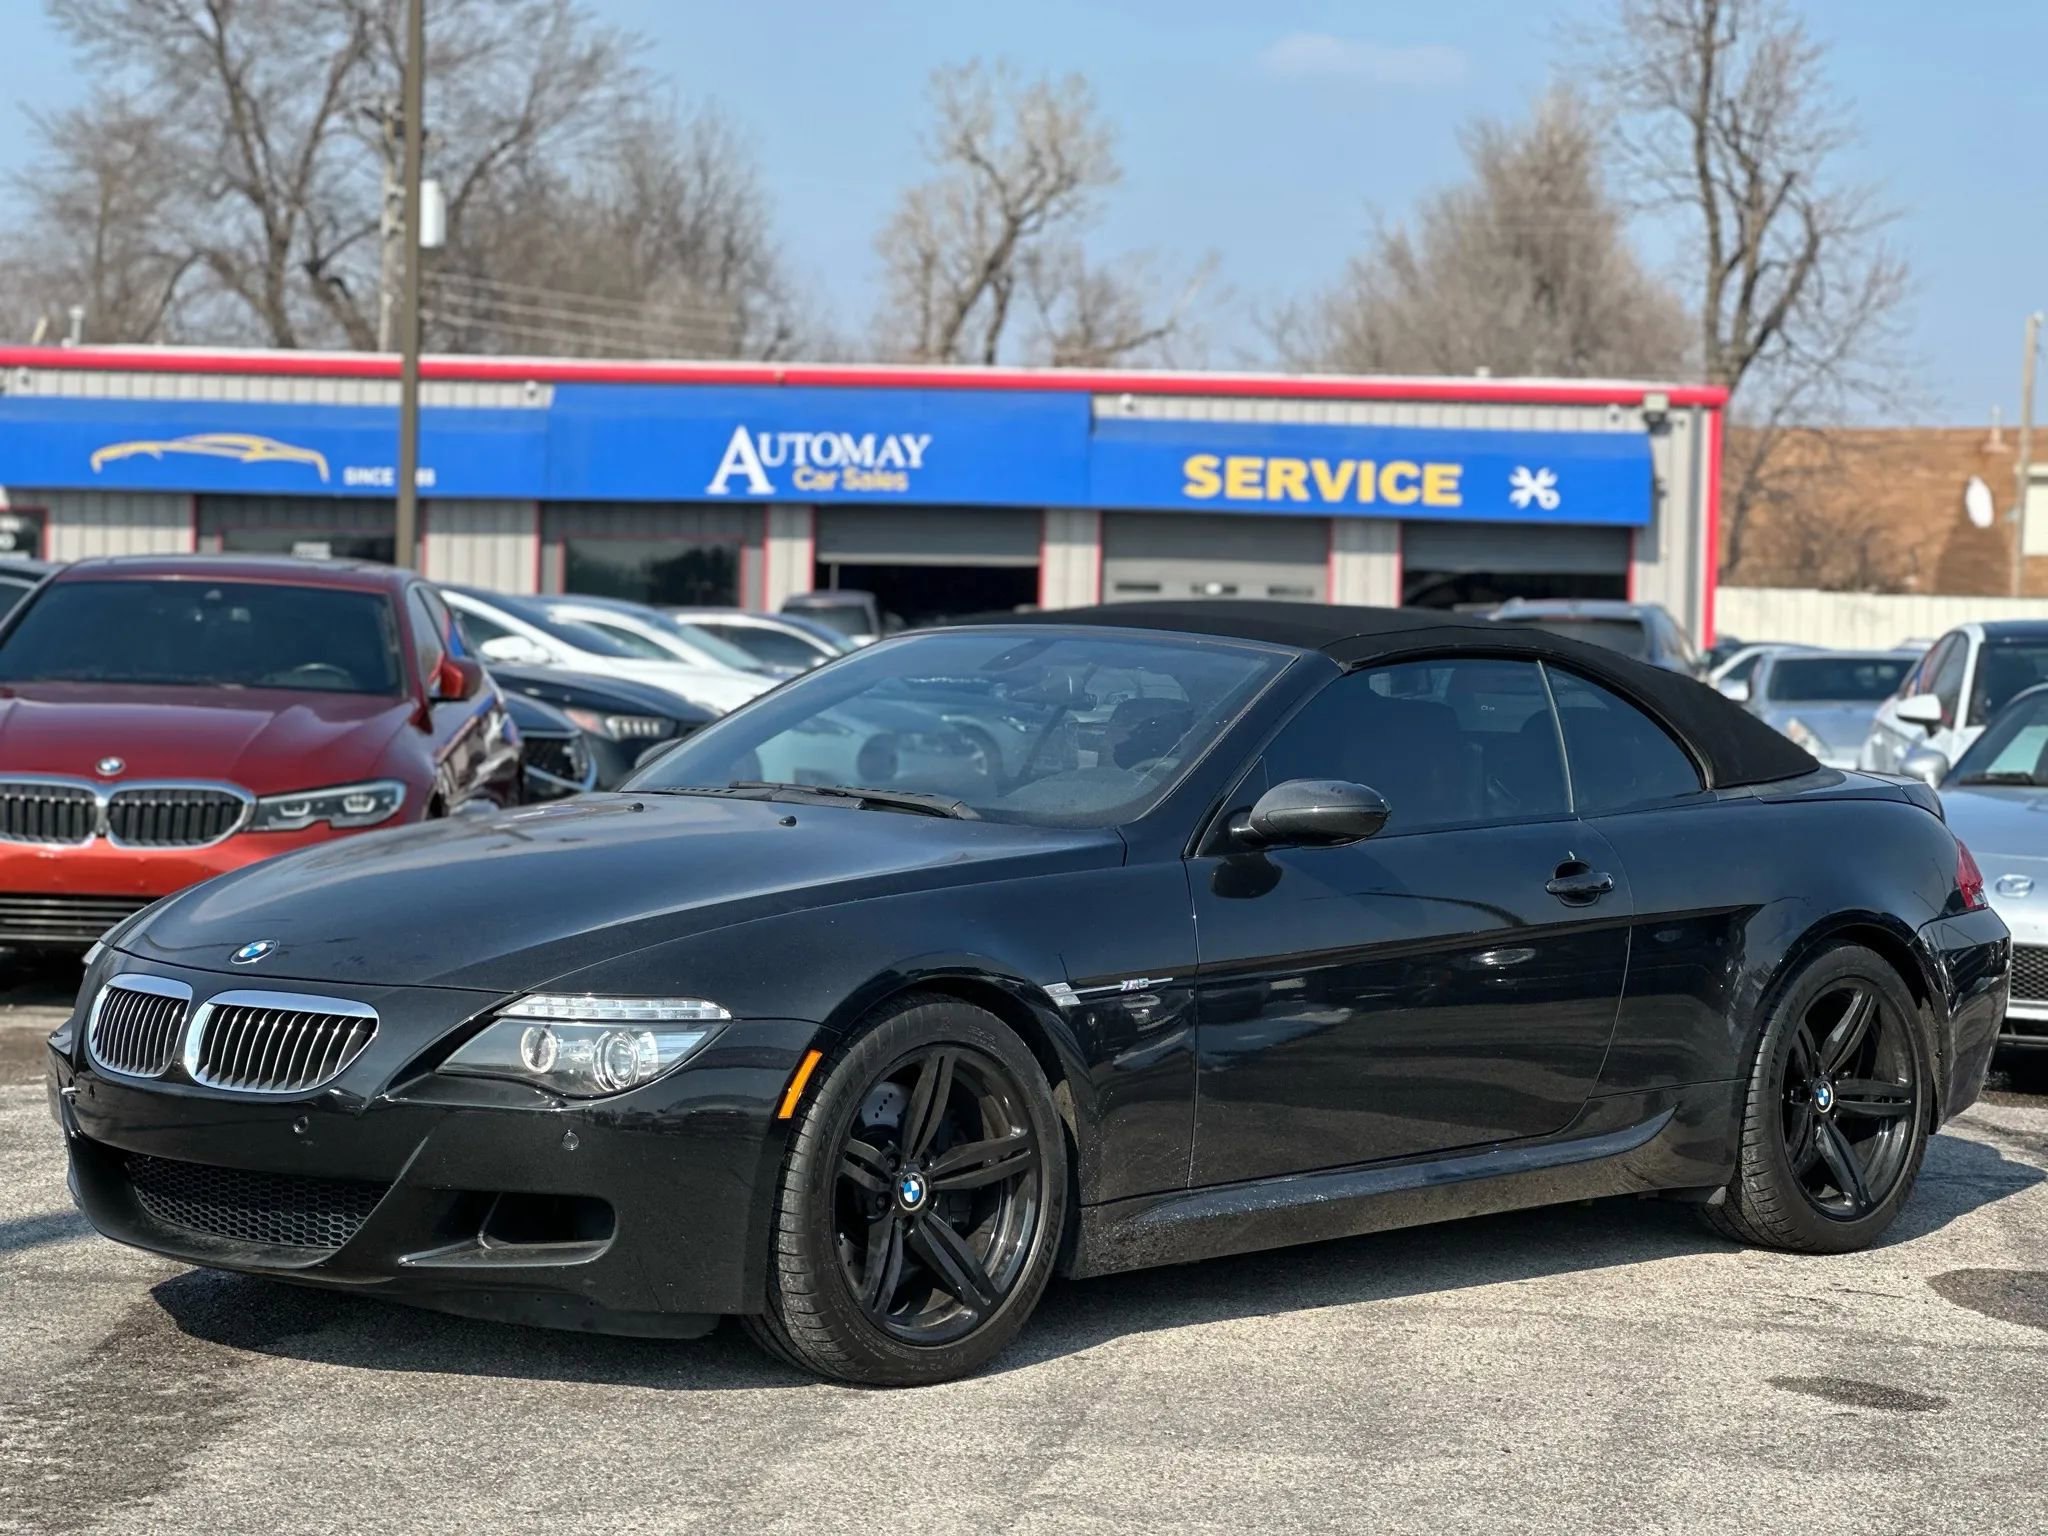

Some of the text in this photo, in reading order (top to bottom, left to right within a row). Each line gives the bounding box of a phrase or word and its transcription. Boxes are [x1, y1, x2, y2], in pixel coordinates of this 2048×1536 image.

[706, 425, 932, 495] AUTOMAY
[793, 465, 838, 491] Car
[1183, 454, 1462, 507] SERVICE
